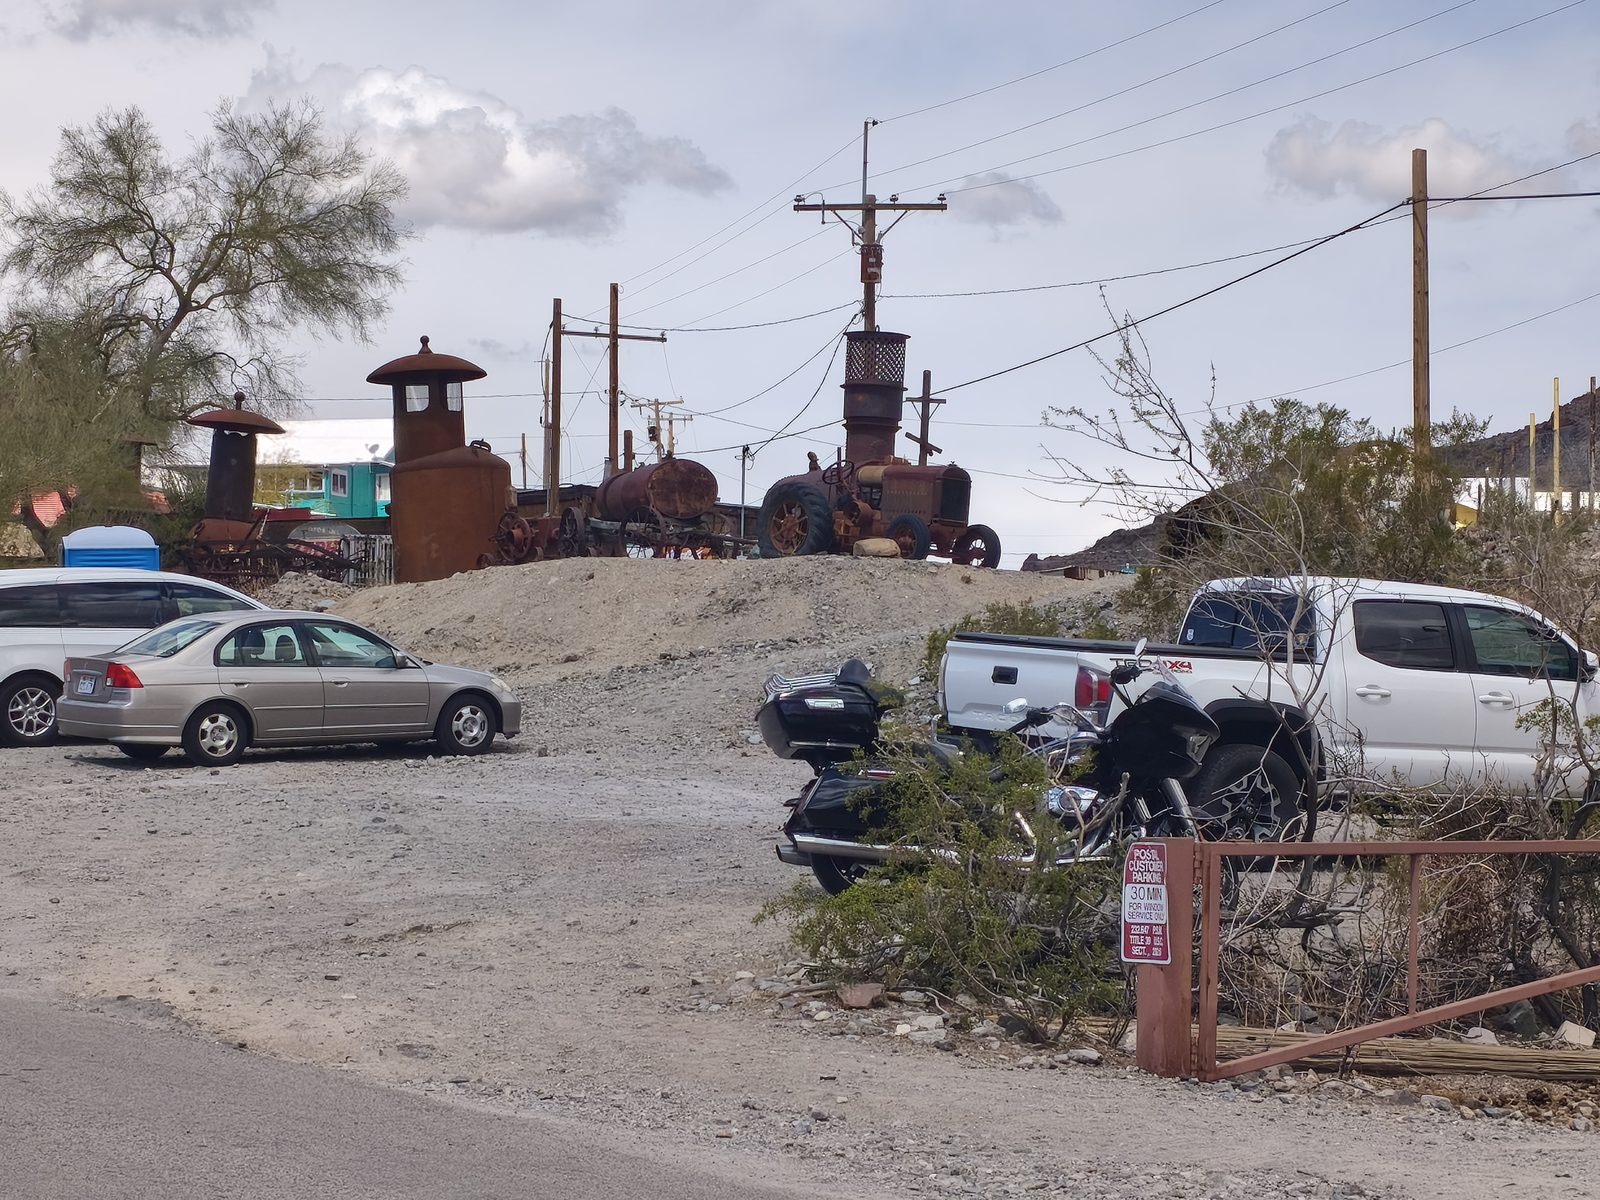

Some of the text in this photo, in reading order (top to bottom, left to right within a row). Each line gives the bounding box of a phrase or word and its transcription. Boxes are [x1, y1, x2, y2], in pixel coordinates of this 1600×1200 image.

[1132, 871, 1162, 883] PARKING
[1130, 886, 1162, 901] 30 MIN
[1129, 902, 1142, 911] FOR
[1128, 911, 1153, 920] SERVICE
